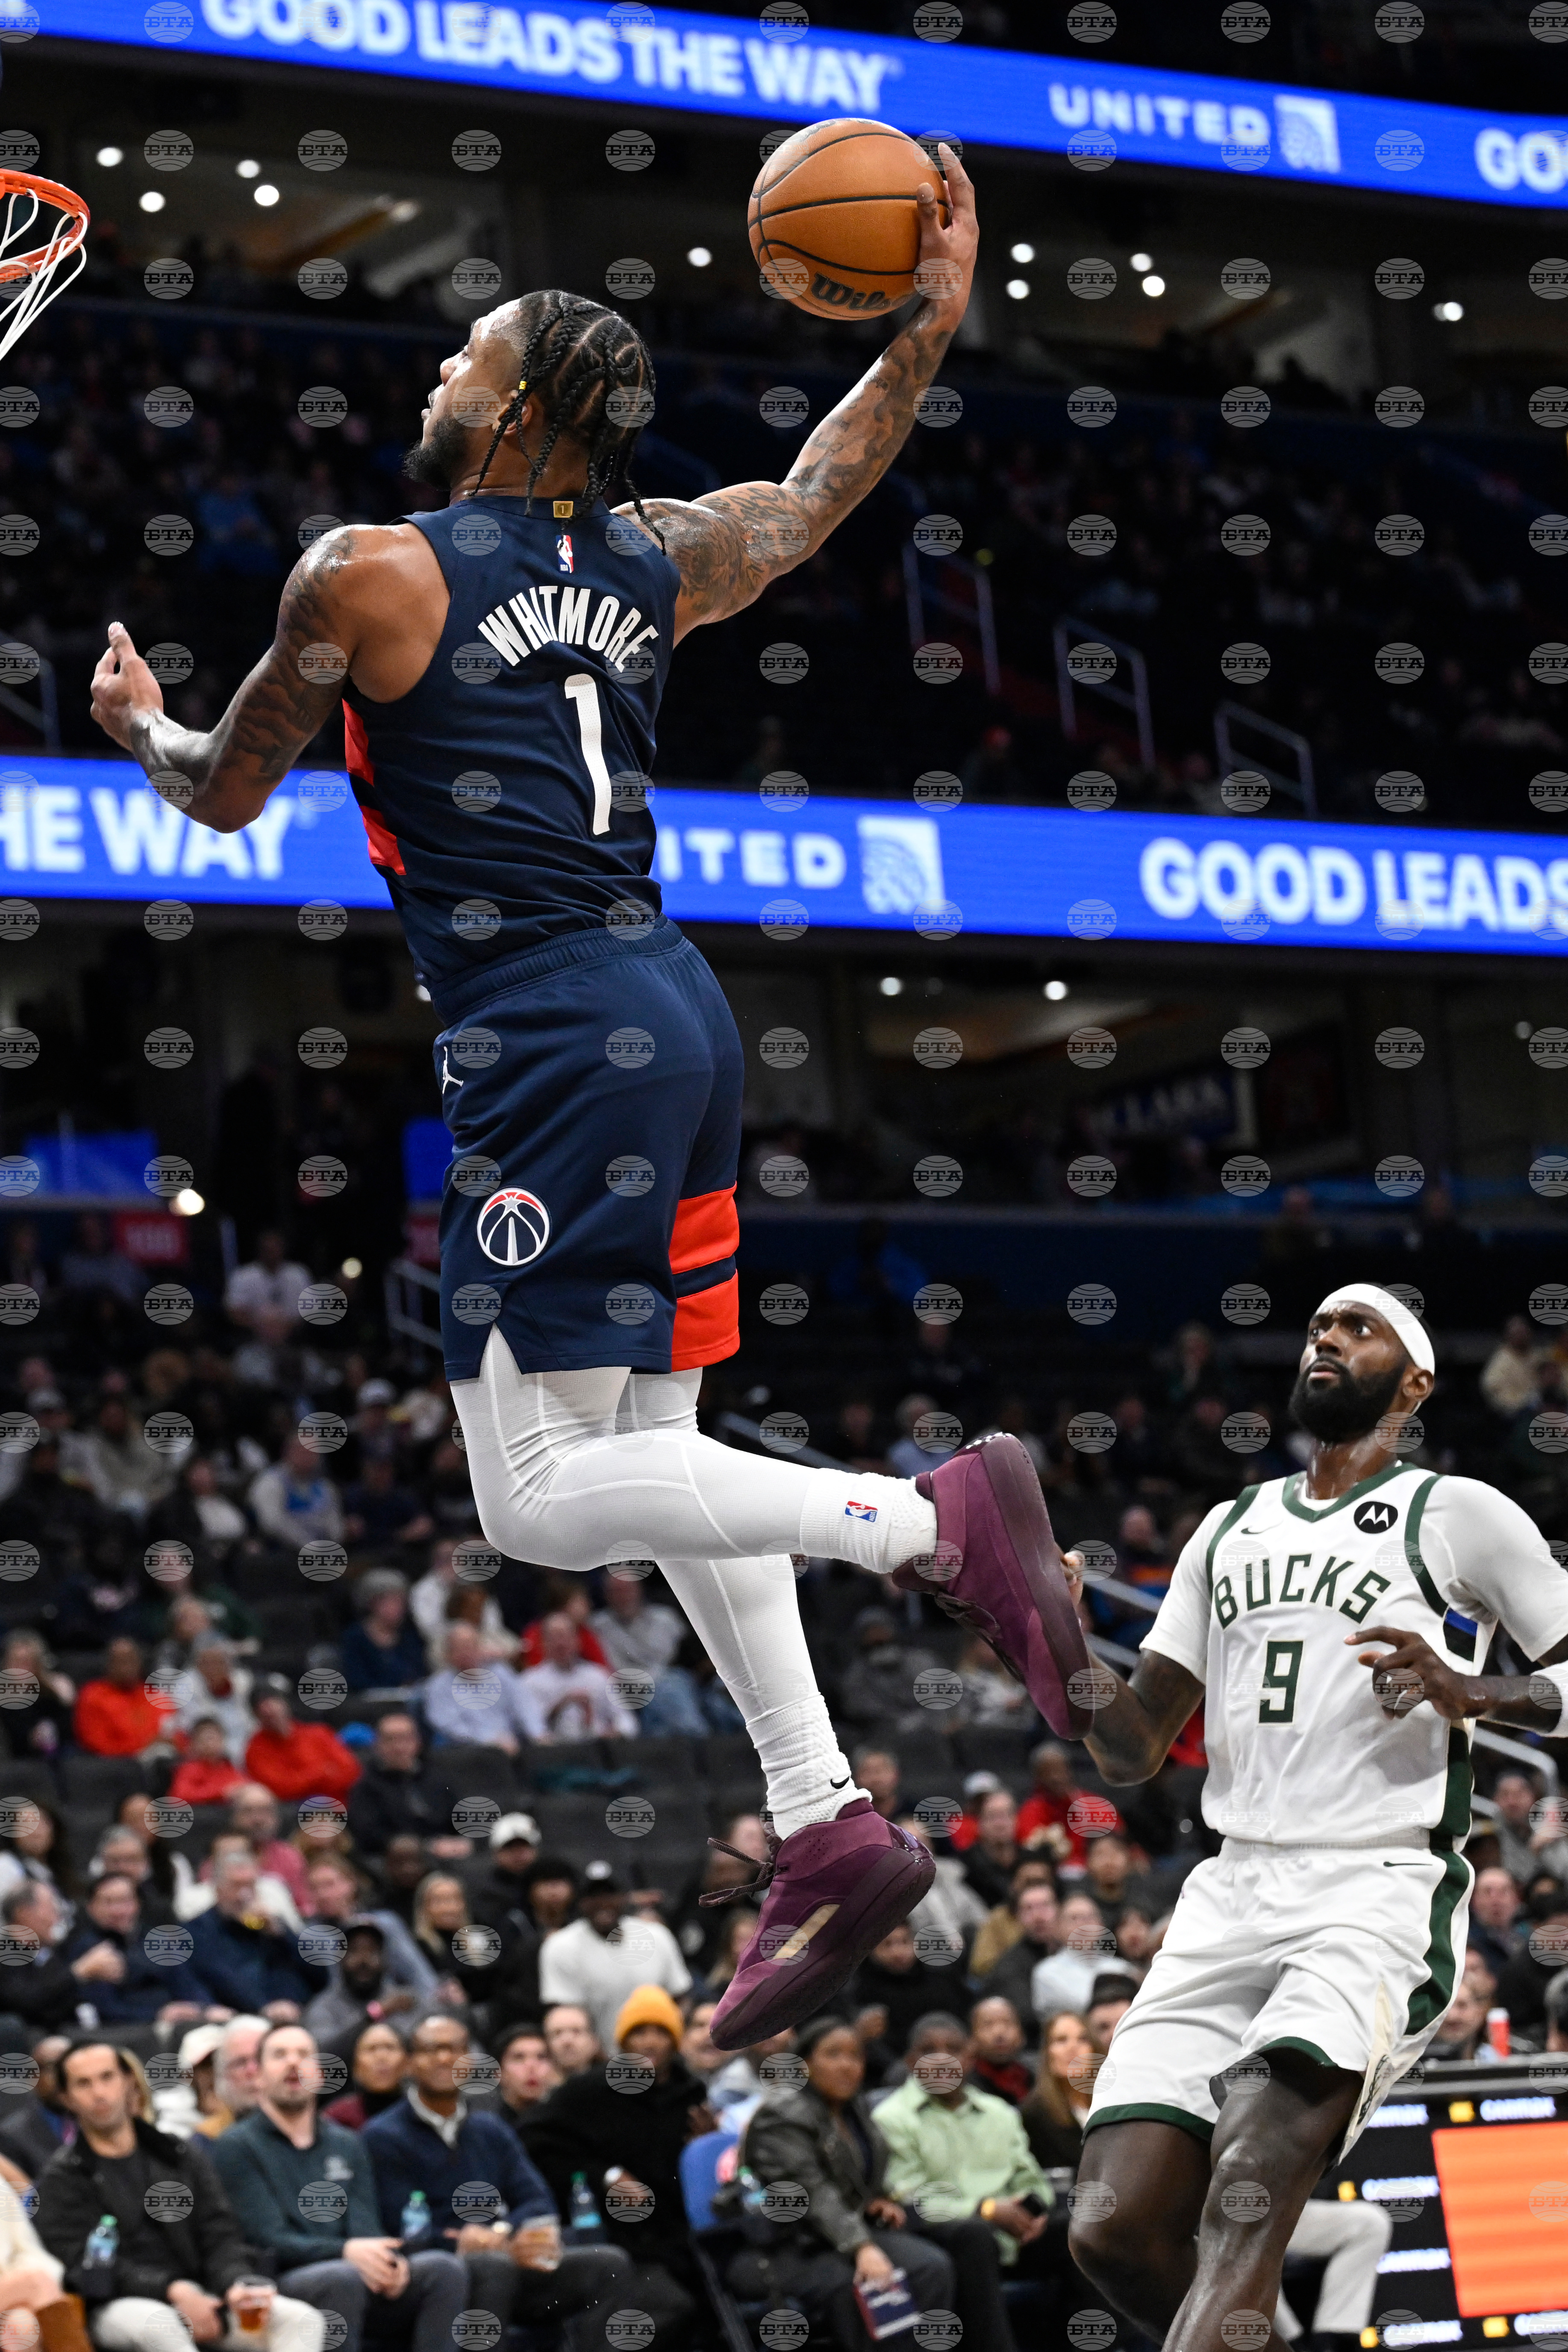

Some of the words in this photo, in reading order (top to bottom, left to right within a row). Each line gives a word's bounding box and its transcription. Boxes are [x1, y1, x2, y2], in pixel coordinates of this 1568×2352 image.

[202, 0, 411, 56] GOOD
[414, 0, 622, 84] LEADS
[623, 25, 745, 98] THE
[744, 38, 890, 113] WAY
[1048, 82, 1271, 147] UNITED
[1474, 127, 1568, 193] GO
[478, 585, 659, 673] WHITMORE
[564, 673, 612, 836] 1
[0, 785, 86, 873] HE
[89, 787, 297, 881] WAY
[656, 825, 848, 889] ITED
[1139, 836, 1366, 926] GOOD
[1214, 1553, 1391, 1630] BUCKS
[1258, 1640, 1303, 1724] 9
